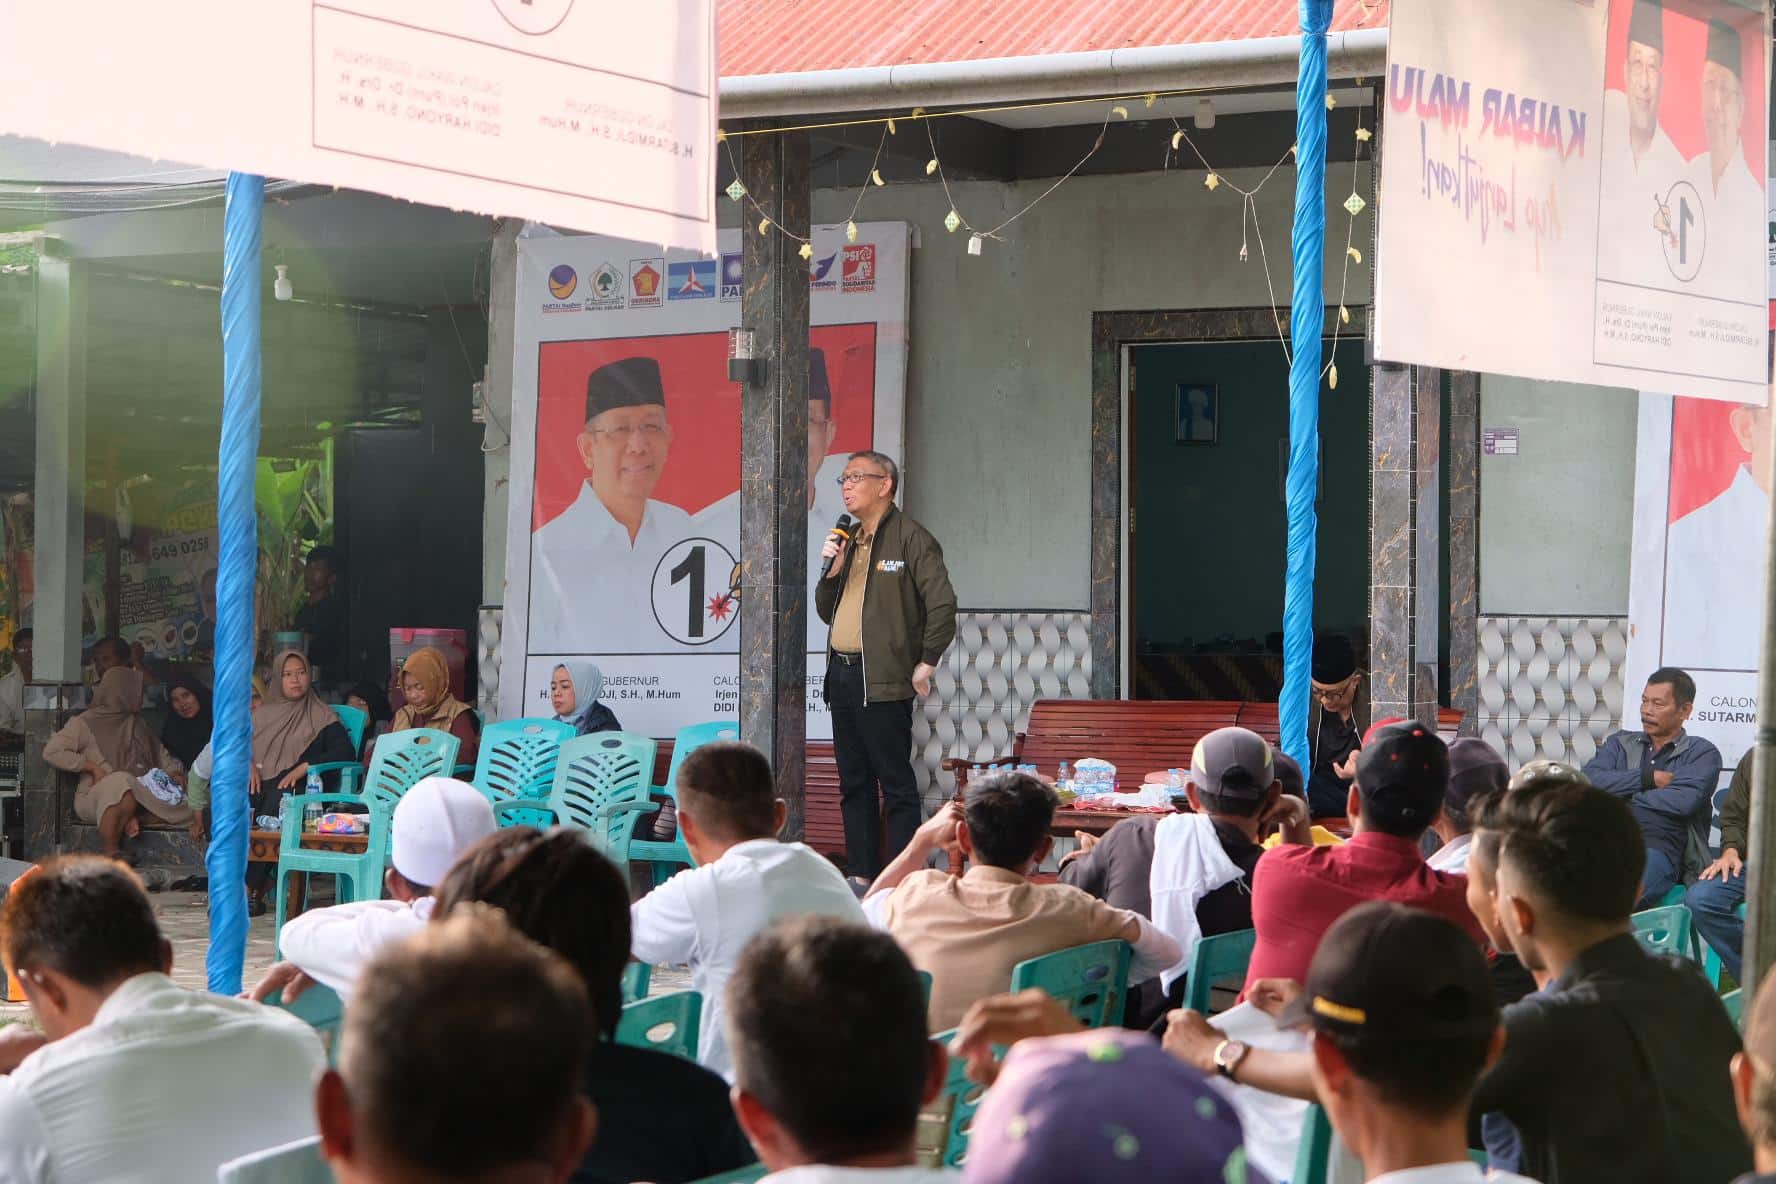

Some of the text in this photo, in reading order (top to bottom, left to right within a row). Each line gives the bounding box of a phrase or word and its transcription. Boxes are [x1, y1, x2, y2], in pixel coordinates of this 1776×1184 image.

[843, 249, 859, 262] PSI
[721, 286, 743, 298] PA
[670, 546, 706, 638] 1
[601, 676, 660, 687] GUBERNUR
[620, 689, 643, 701] S.H.,
[646, 689, 681, 700] M.Hum
[715, 689, 738, 701] Irjen
[713, 703, 735, 712] DIDI
[1711, 696, 1758, 708] CALON
[1697, 711, 1757, 724] SUTARM
